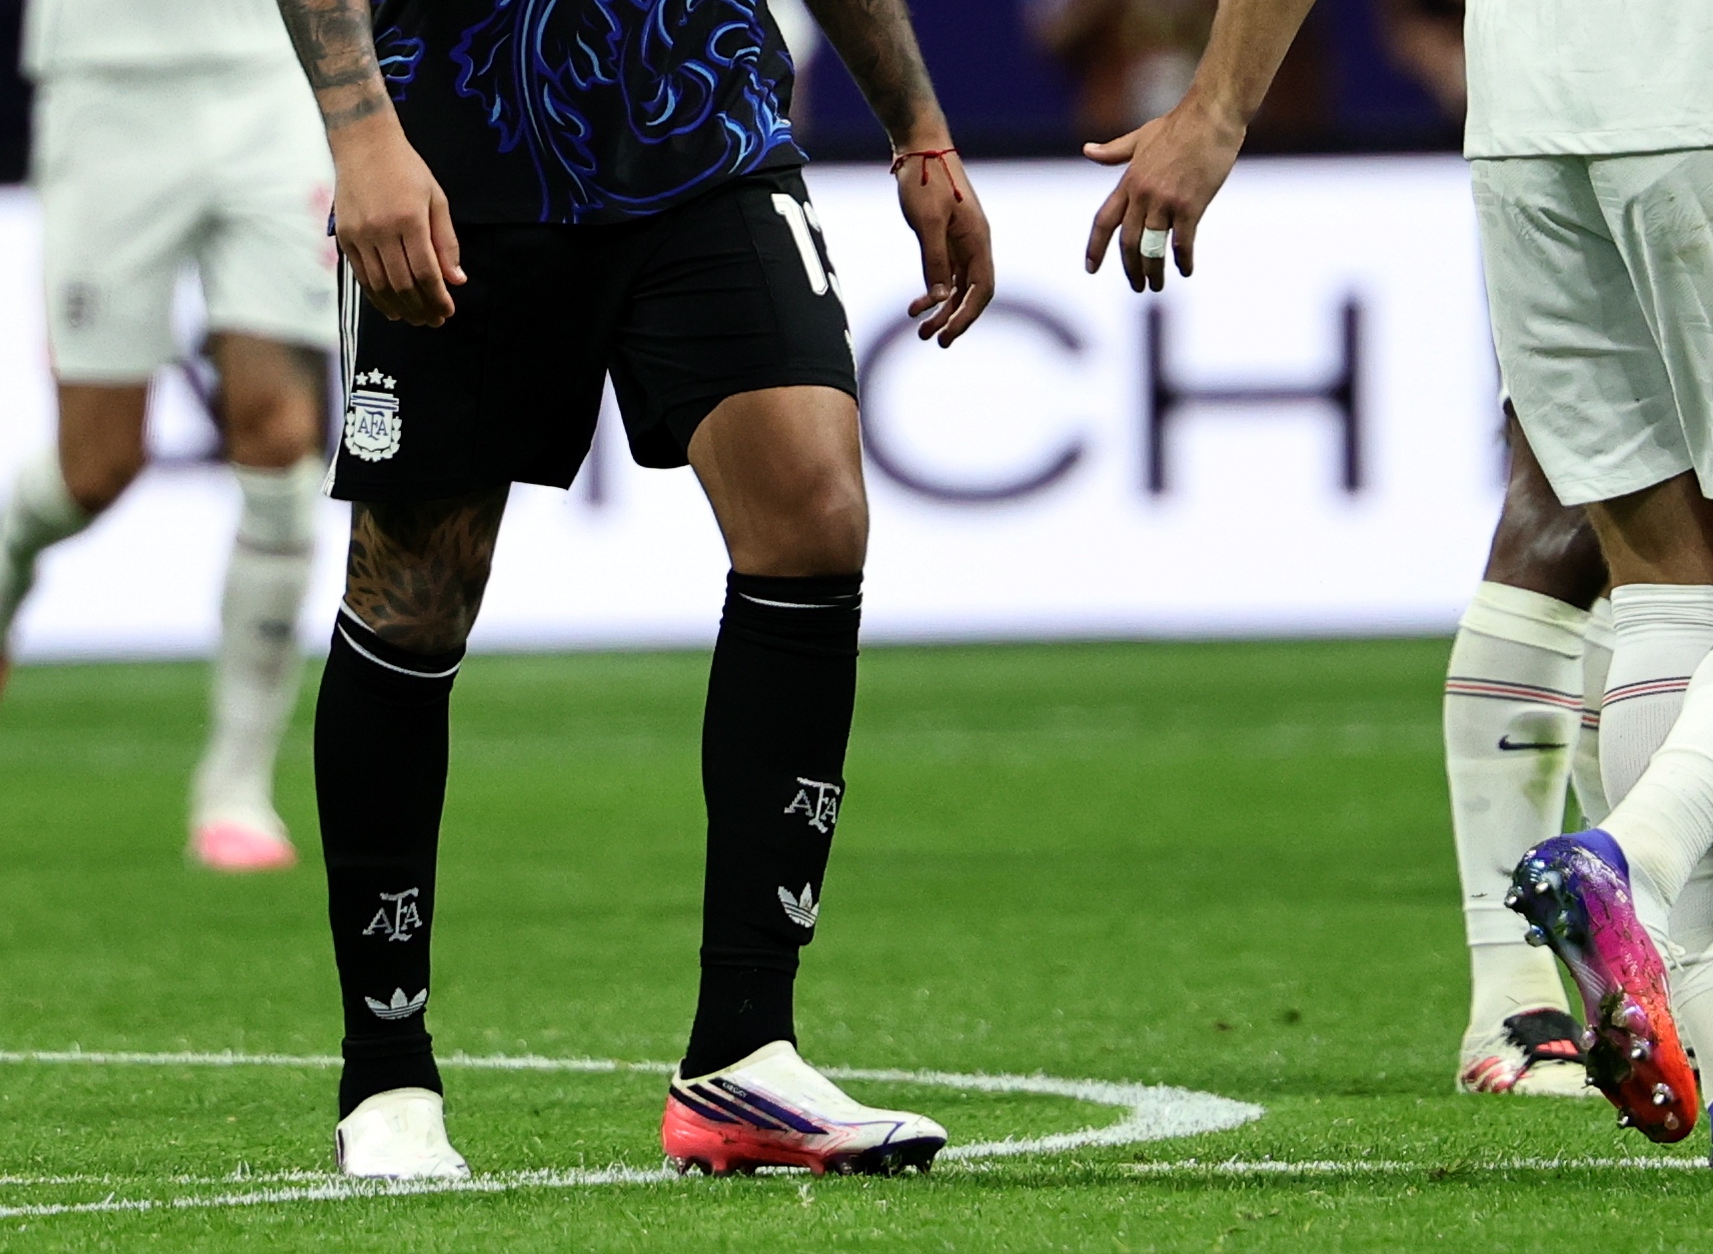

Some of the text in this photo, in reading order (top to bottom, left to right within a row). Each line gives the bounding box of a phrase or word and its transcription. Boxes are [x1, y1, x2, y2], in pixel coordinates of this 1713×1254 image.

[357, 408, 389, 441] AFA
[783, 776, 841, 833] AFA
[362, 886, 423, 942] AFA
